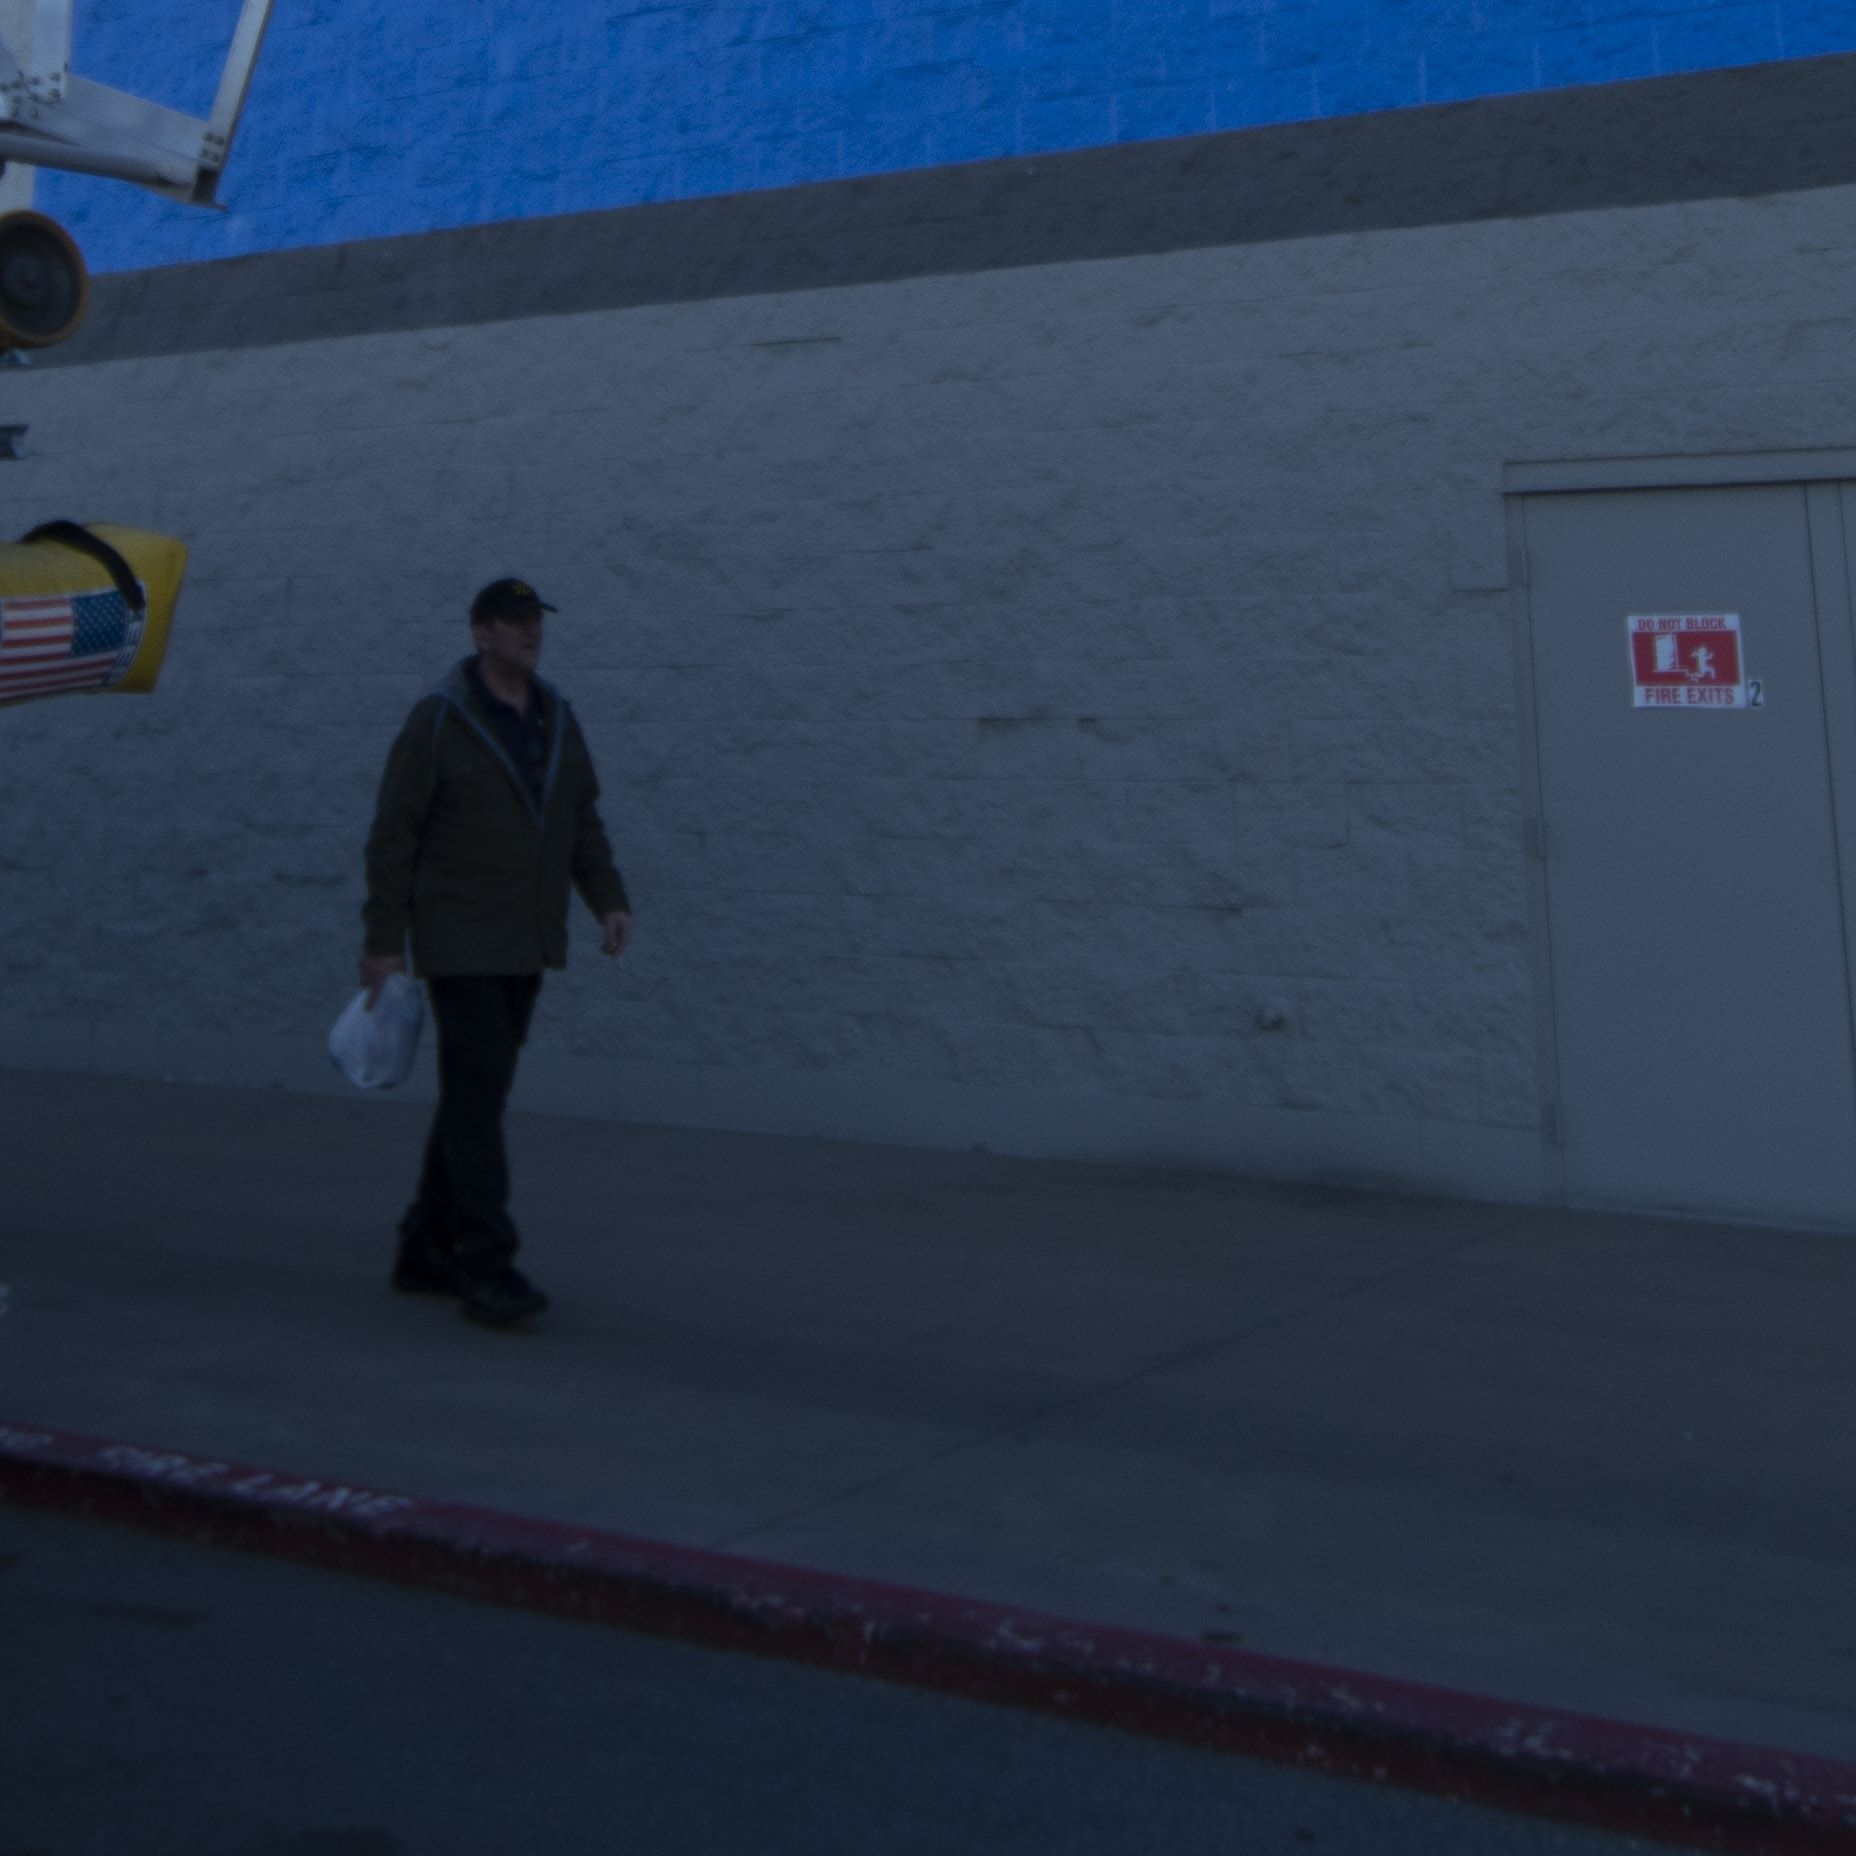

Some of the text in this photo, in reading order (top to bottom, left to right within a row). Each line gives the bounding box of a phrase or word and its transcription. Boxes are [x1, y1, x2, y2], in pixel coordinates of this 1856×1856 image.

[1638, 617, 1726, 631] DO NOT BLOCK
[1645, 686, 1735, 705] FIRE EXITS
[1750, 681, 1763, 707] 2
